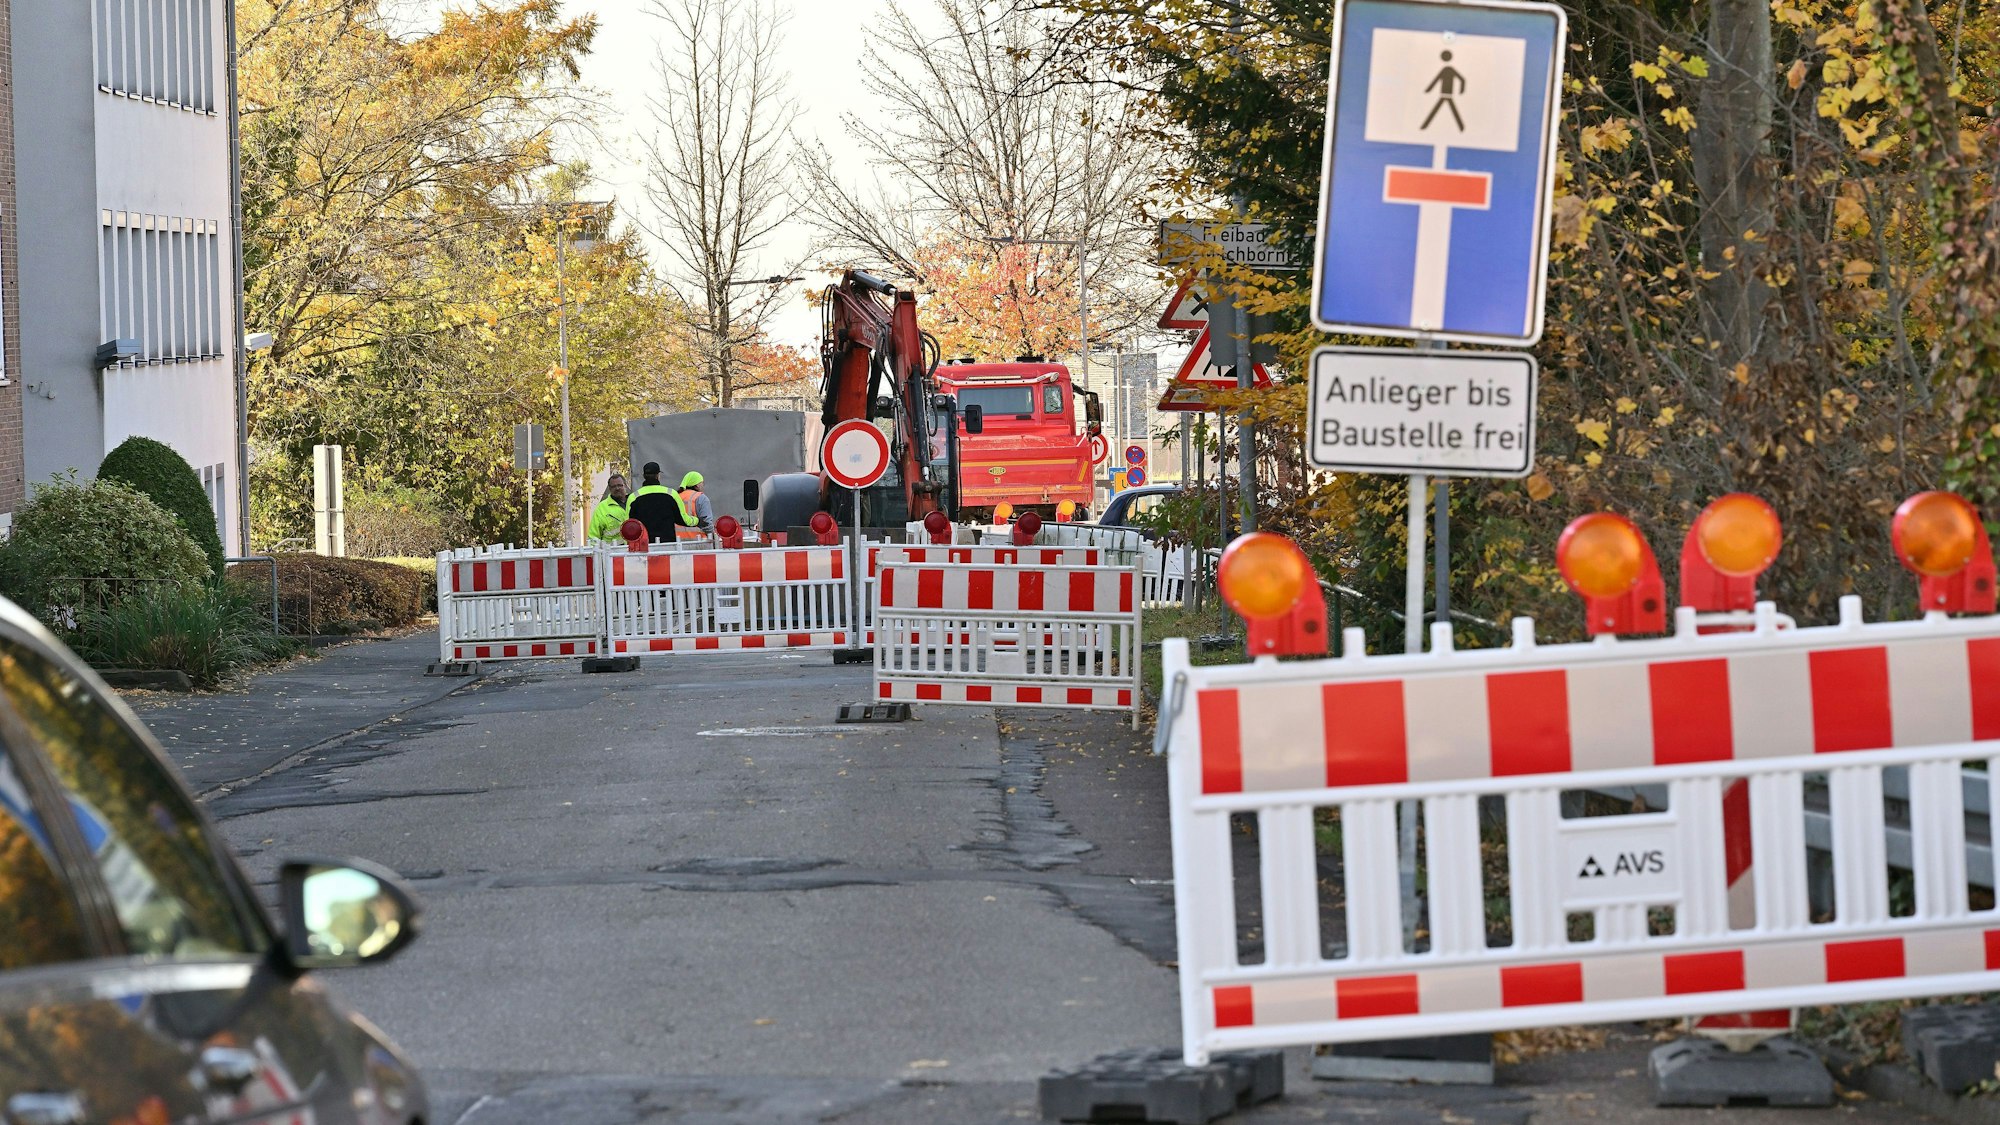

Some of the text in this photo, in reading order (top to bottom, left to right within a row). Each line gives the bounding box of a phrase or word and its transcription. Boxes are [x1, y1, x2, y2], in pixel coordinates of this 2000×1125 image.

[1325, 376, 1511, 411] Anlieger bis
[1321, 419, 1524, 450] Baustelle frei
[1614, 850, 1664, 876] AVS
